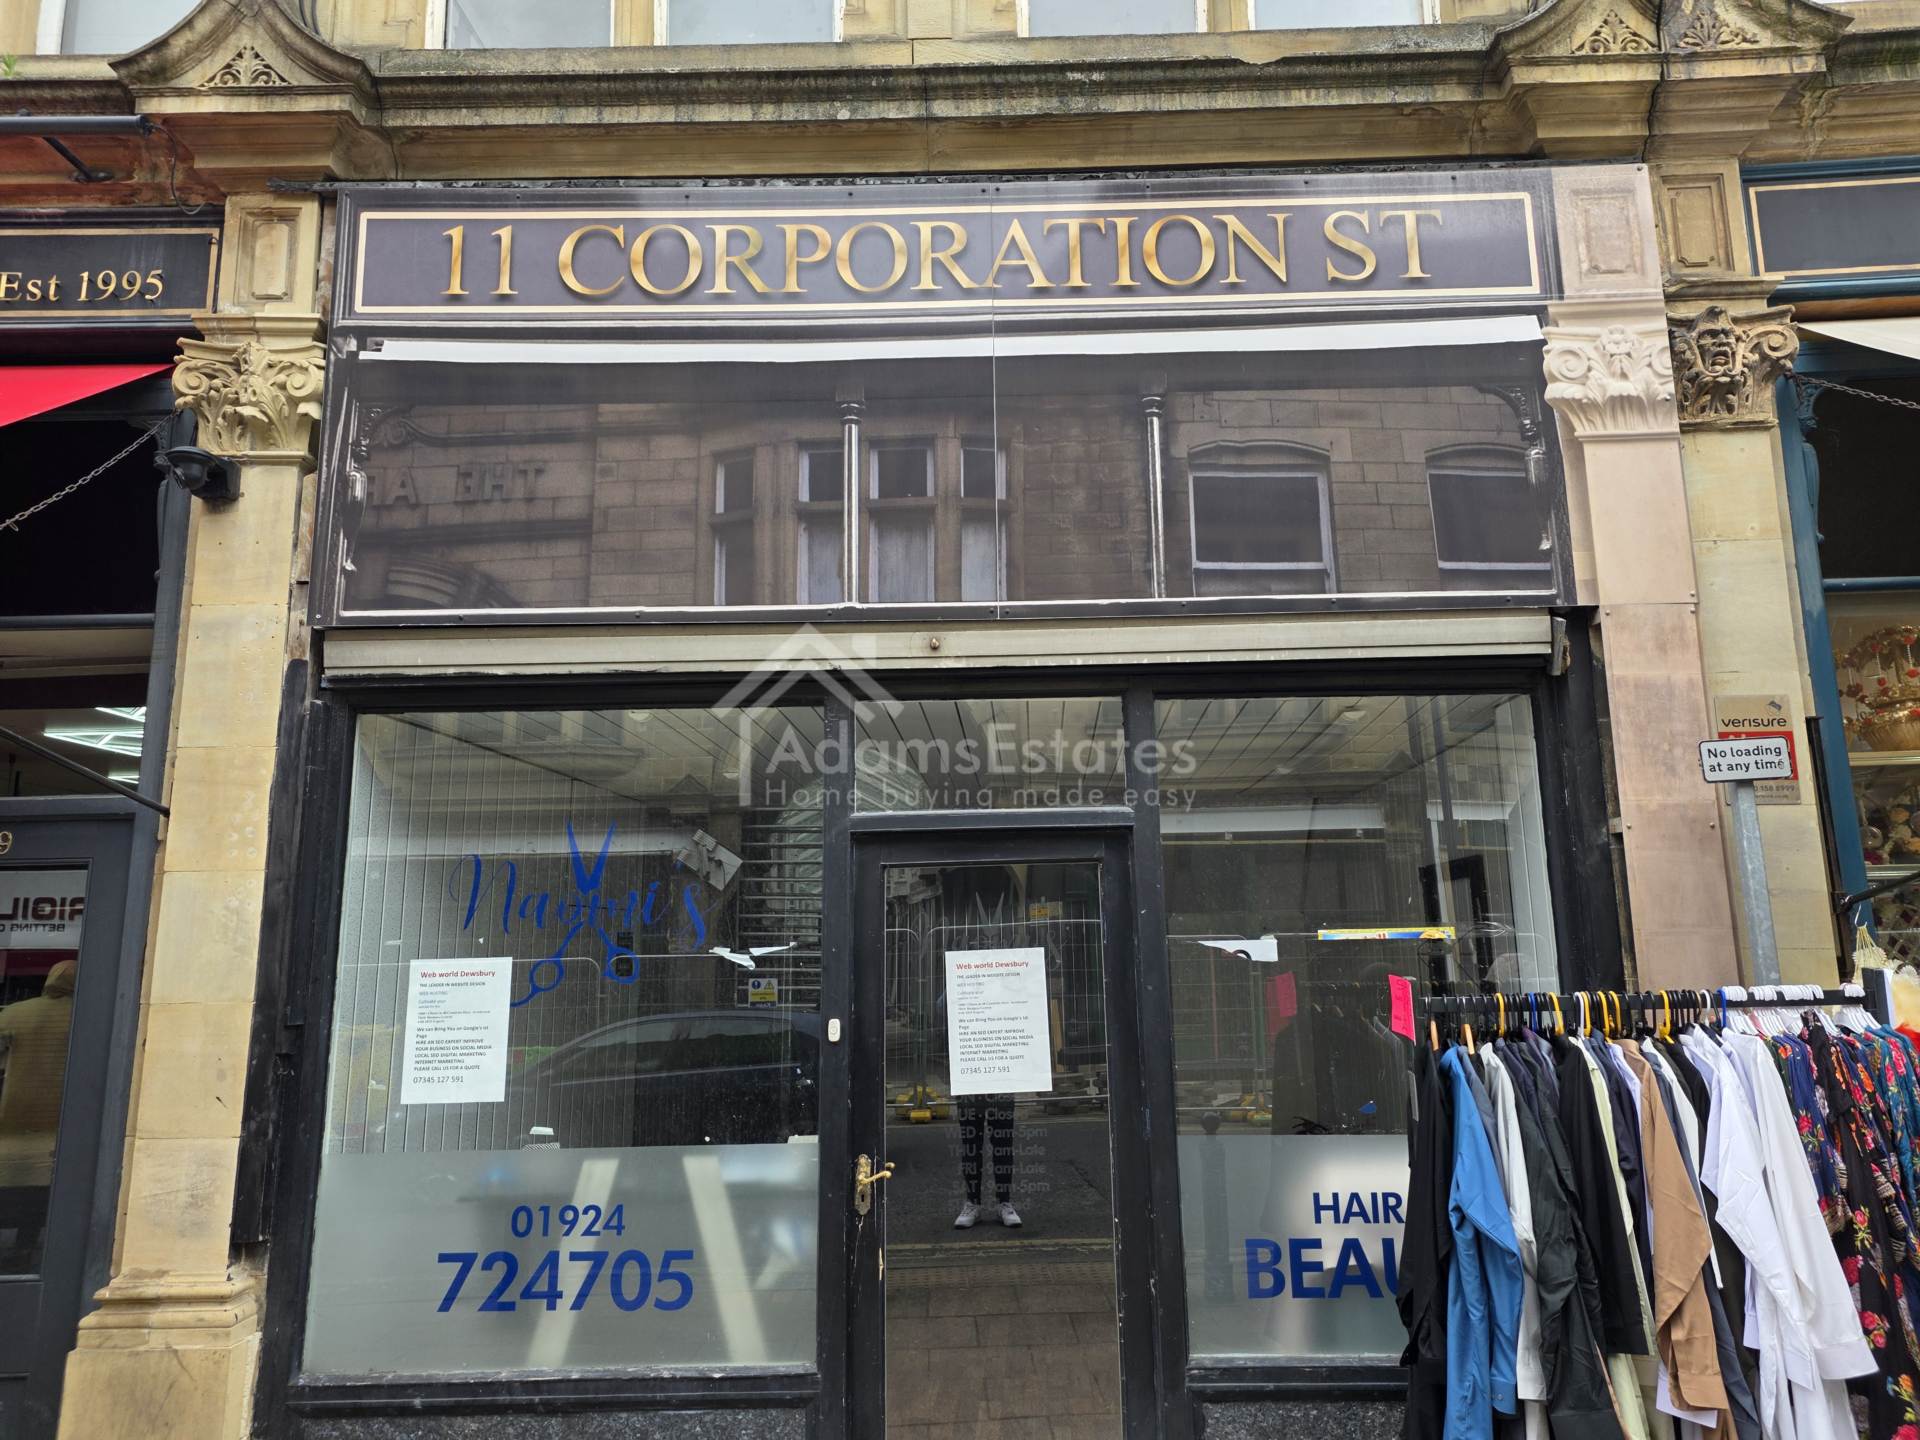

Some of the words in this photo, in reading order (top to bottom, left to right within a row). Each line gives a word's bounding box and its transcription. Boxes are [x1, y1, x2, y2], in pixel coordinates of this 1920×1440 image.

[439, 225, 519, 296] 11
[558, 213, 1293, 296] CORPORATION
[1324, 209, 1443, 282] ST
[0, 271, 61, 302] Est
[77, 269, 164, 302] 1995
[1721, 717, 1787, 728] verisure
[1707, 748, 1728, 759] No
[1730, 745, 1782, 758] loading
[1709, 761, 1724, 773] at
[1727, 761, 1751, 773] any
[1755, 758, 1785, 770] time
[511, 1203, 626, 1238] 01924
[1312, 1192, 1405, 1224] HAIR
[436, 1248, 695, 1312] 724705
